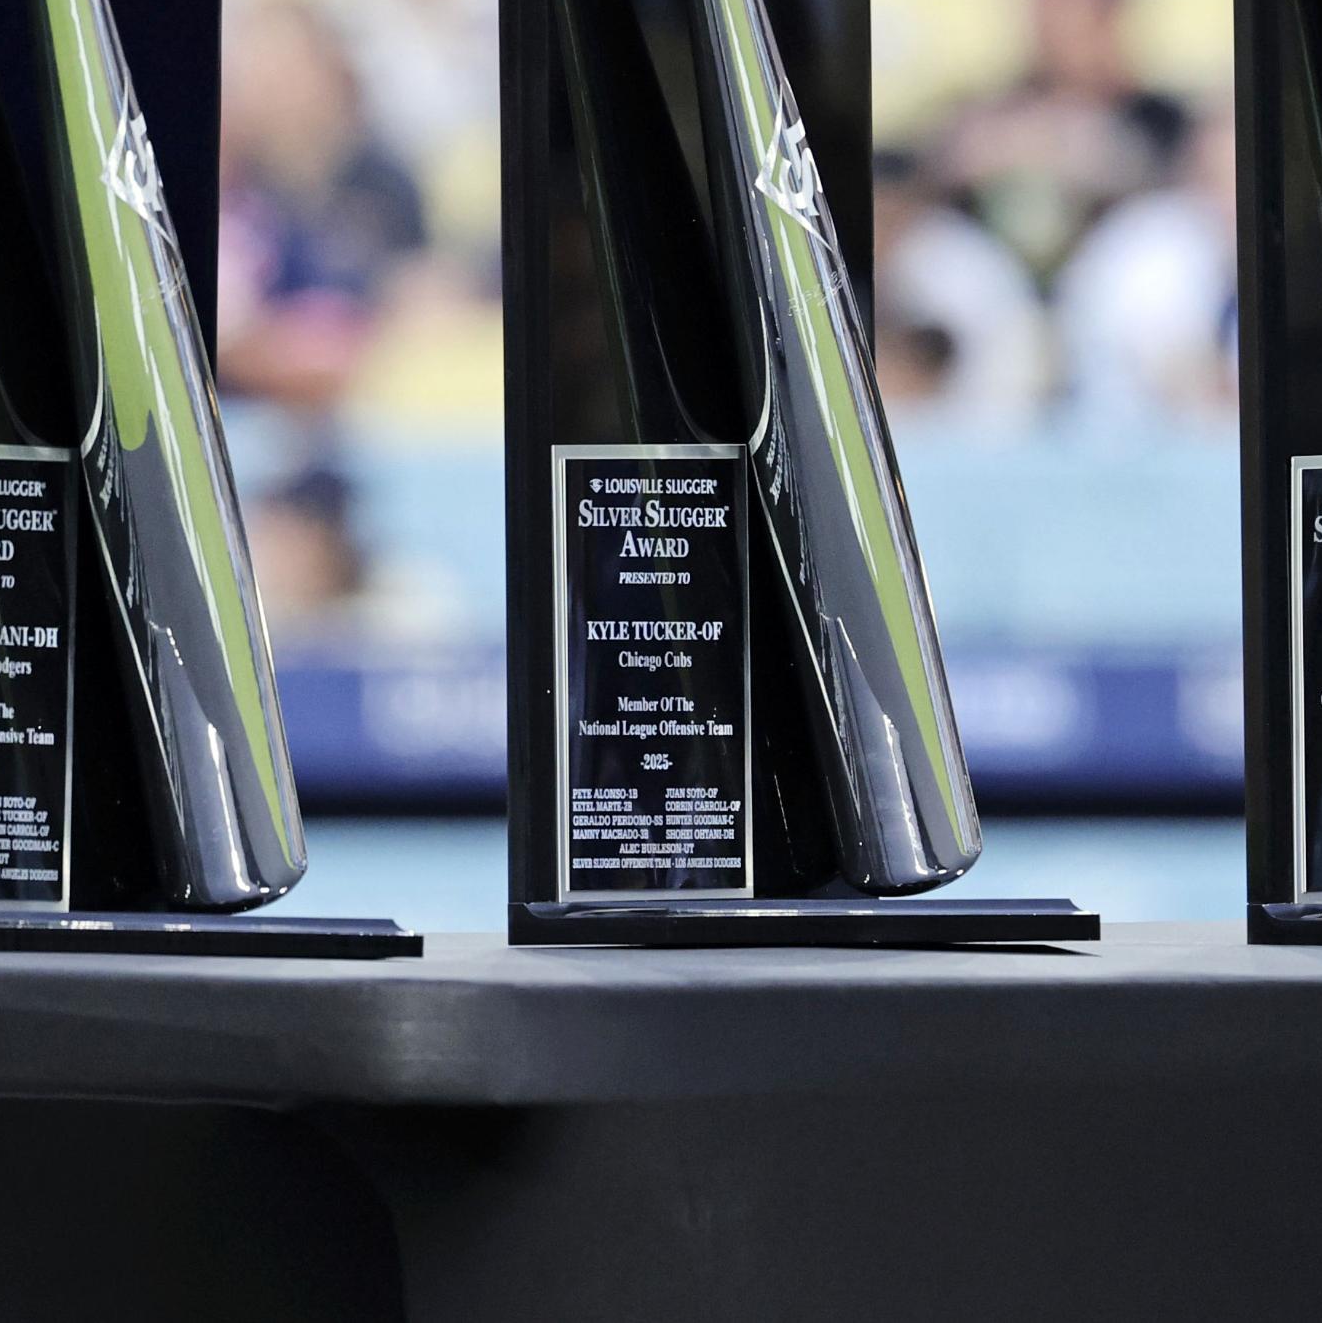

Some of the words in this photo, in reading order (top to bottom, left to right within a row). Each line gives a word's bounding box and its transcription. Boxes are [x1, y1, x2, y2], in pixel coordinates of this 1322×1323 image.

[605, 478, 664, 494] LOUISVILLE
[578, 499, 643, 527] SILVER
[619, 530, 689, 558] AWARD
[1, 574, 15, 588] TO
[619, 572, 675, 584] PRESENTED
[677, 572, 690, 584] TO
[587, 621, 629, 640] KYLE
[631, 621, 723, 641] TUCKER-OF
[618, 650, 661, 671] Chicago
[664, 651, 692, 668] Cubs
[617, 696, 659, 712] Member
[660, 696, 676, 712] Of
[676, 696, 694, 712] The
[27, 728, 55, 745] Team
[578, 720, 620, 736] National
[622, 720, 657, 740] League
[659, 720, 705, 736] Offensive
[706, 720, 733, 736] Team
[640, 753, 673, 770] -2025-
[593, 788, 638, 799] ALONSO-1B
[665, 788, 685, 798] JUAN
[572, 814, 611, 826] GERALDO
[611, 814, 664, 826] PERDOMO-SS
[619, 843, 640, 854] ALEC
